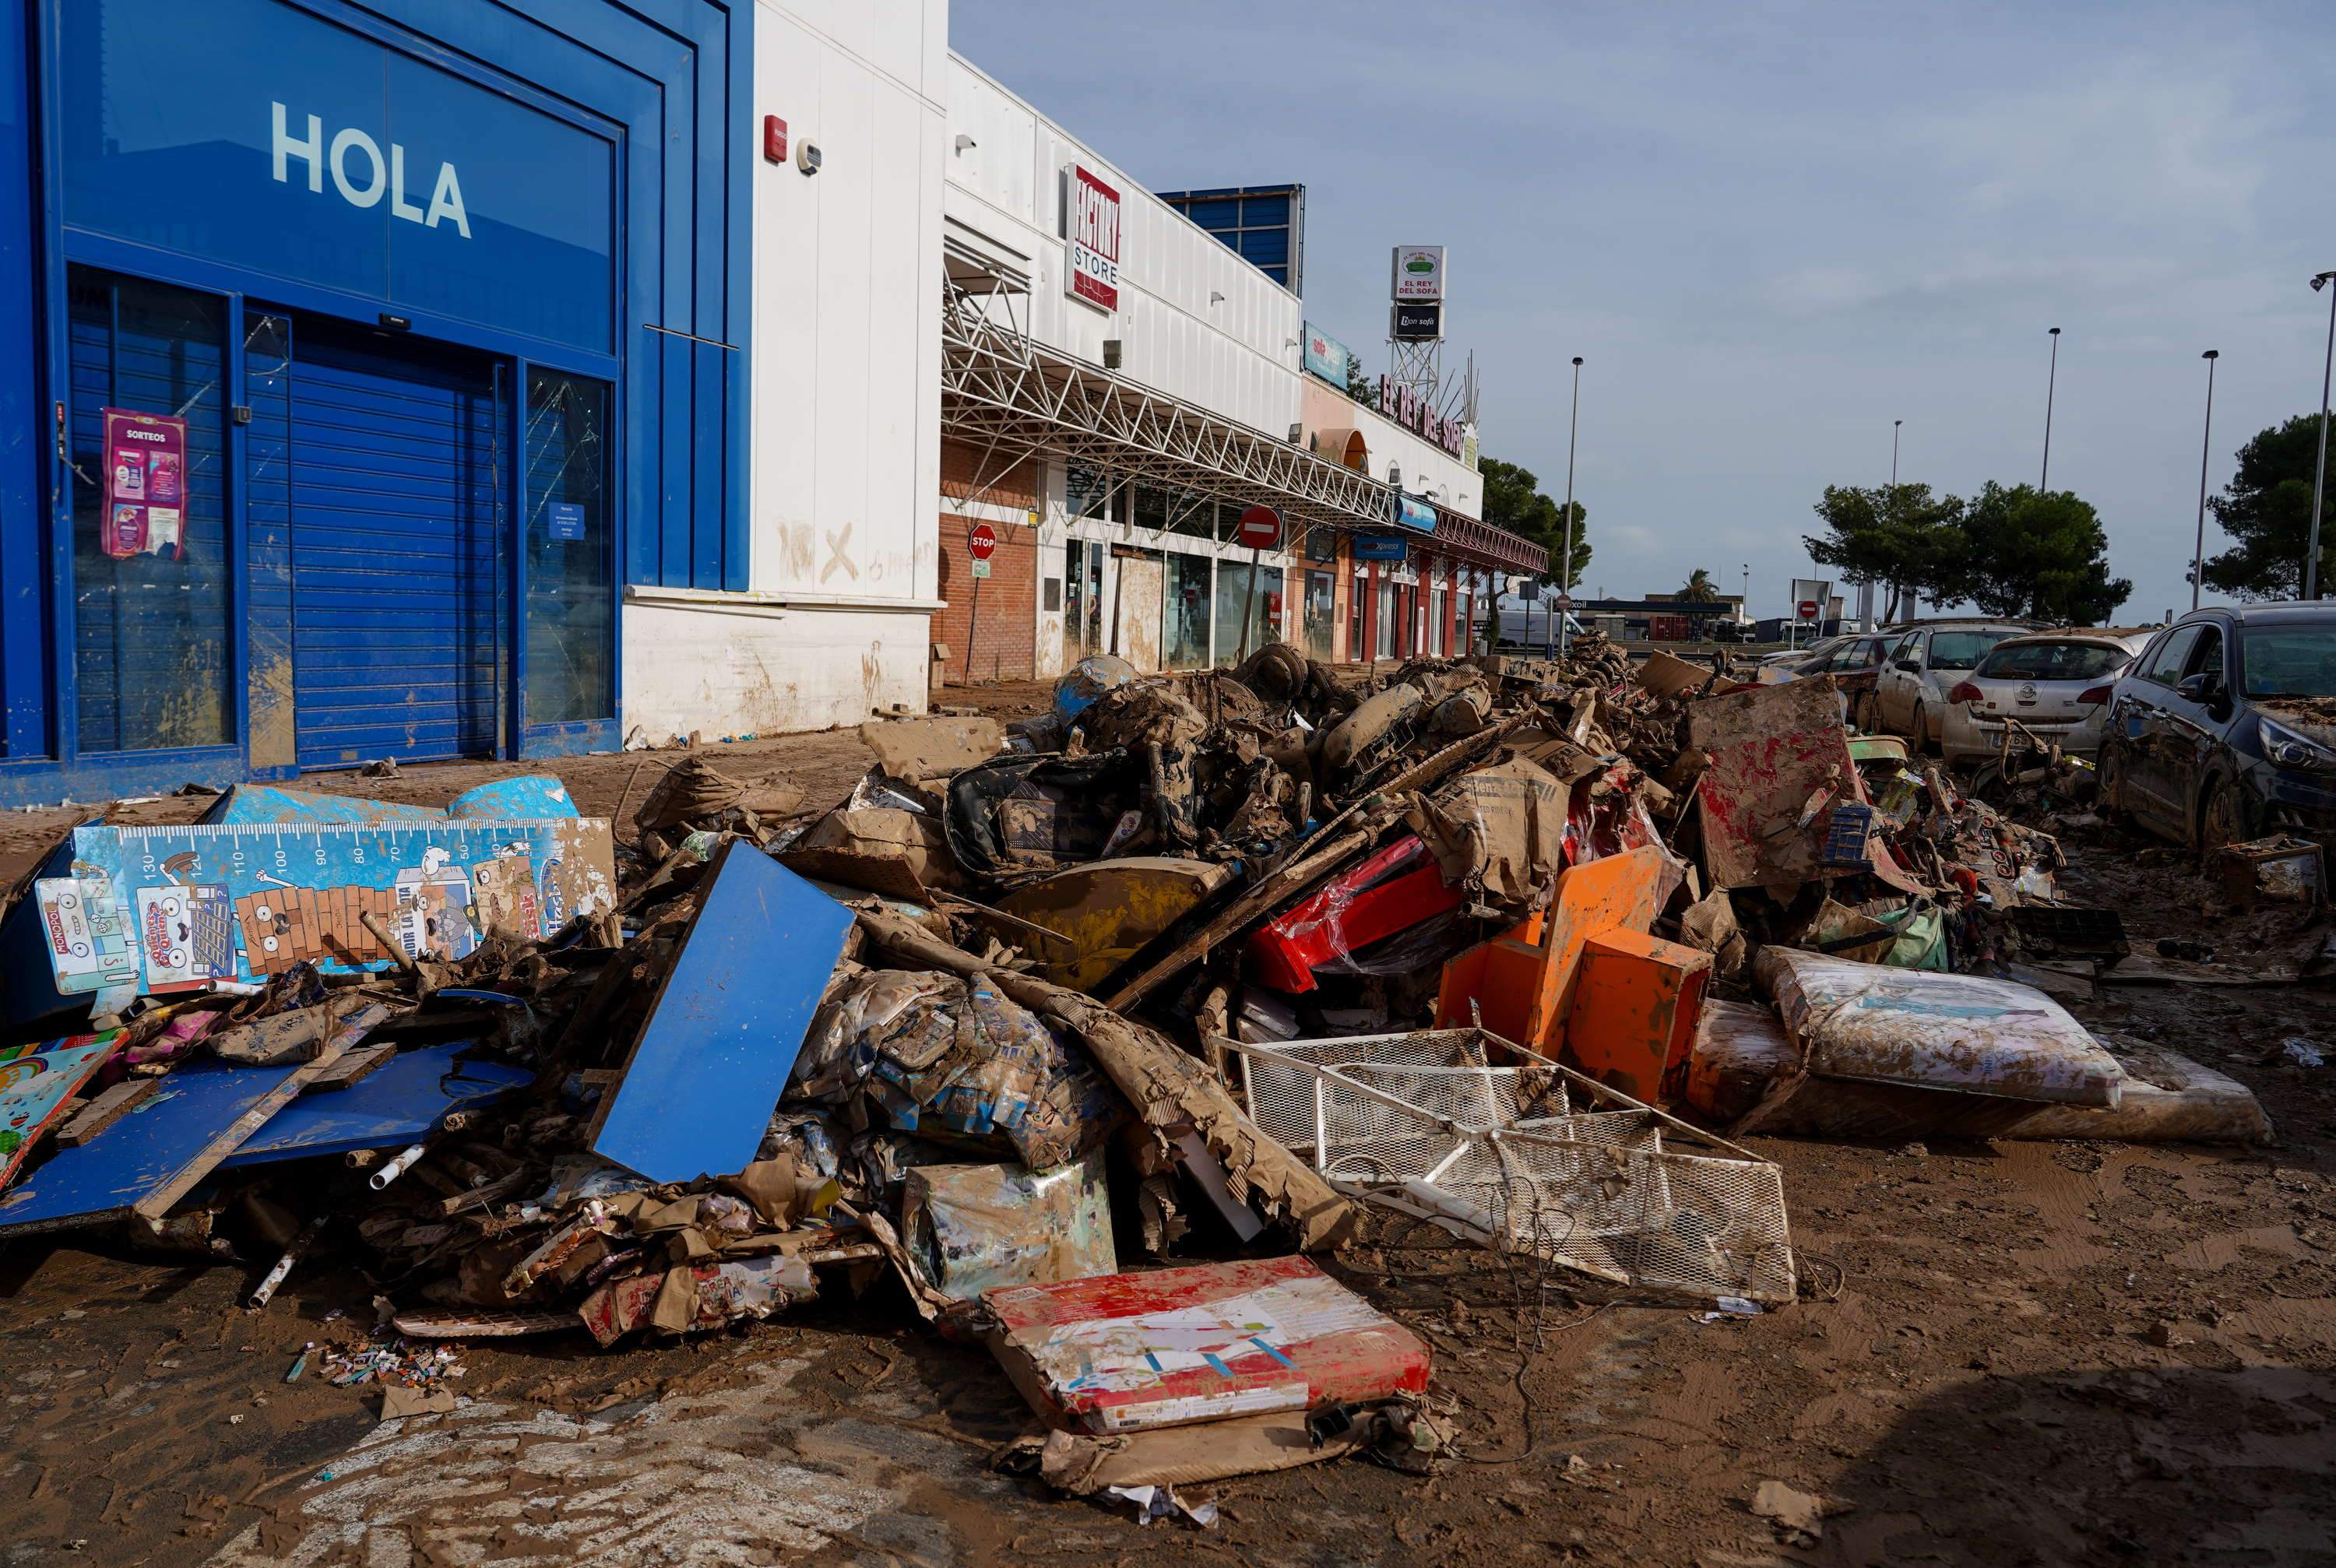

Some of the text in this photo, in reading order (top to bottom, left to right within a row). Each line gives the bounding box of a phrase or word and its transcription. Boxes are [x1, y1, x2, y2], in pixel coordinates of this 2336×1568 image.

[271, 100, 472, 240] HOLA
[1076, 179, 1120, 262] FACTORY
[1075, 247, 1117, 285] STORE
[1381, 374, 1395, 415] EL
[1398, 386, 1418, 430] REY
[1423, 403, 1438, 442] DEL
[126, 430, 166, 442] SORTEOS
[973, 537, 994, 547] STOP
[233, 852, 245, 875] 110
[276, 850, 288, 875] 100
[315, 849, 327, 866] 90
[354, 847, 365, 864] 80
[390, 846, 402, 863] 70
[460, 845, 470, 860] 50
[142, 855, 157, 881] 130
[51, 909, 67, 954] MONOPOL
